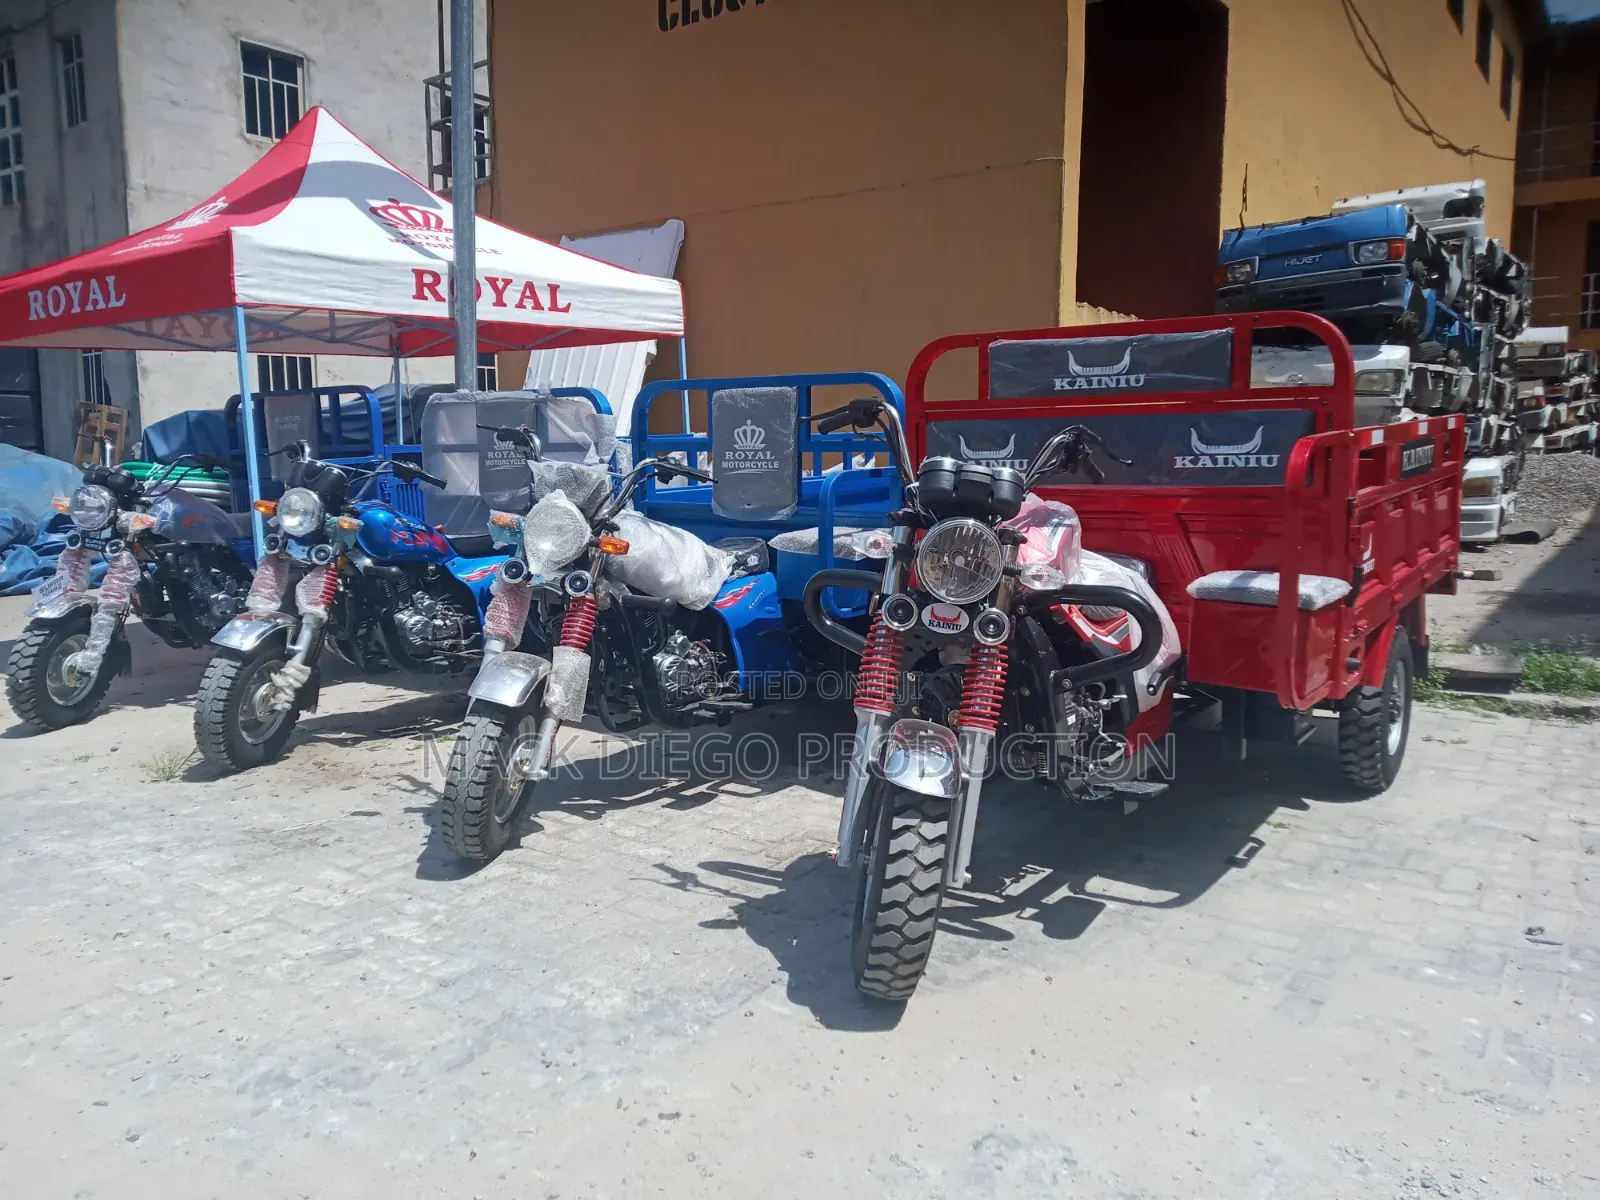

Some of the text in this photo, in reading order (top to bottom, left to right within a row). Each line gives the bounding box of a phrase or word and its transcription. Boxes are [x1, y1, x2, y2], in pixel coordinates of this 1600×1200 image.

[1284, 254, 1322, 267] HIJET
[27, 274, 126, 320] ROYAL
[1053, 374, 1146, 391] KAINIU
[487, 451, 521, 459] ROYAL
[725, 451, 776, 460] ROYAL
[1173, 454, 1280, 469] KAINIU
[1402, 444, 1435, 472] KAINIU
[721, 461, 779, 469] MOTORCYCLE
[927, 619, 962, 631] KAINIU
